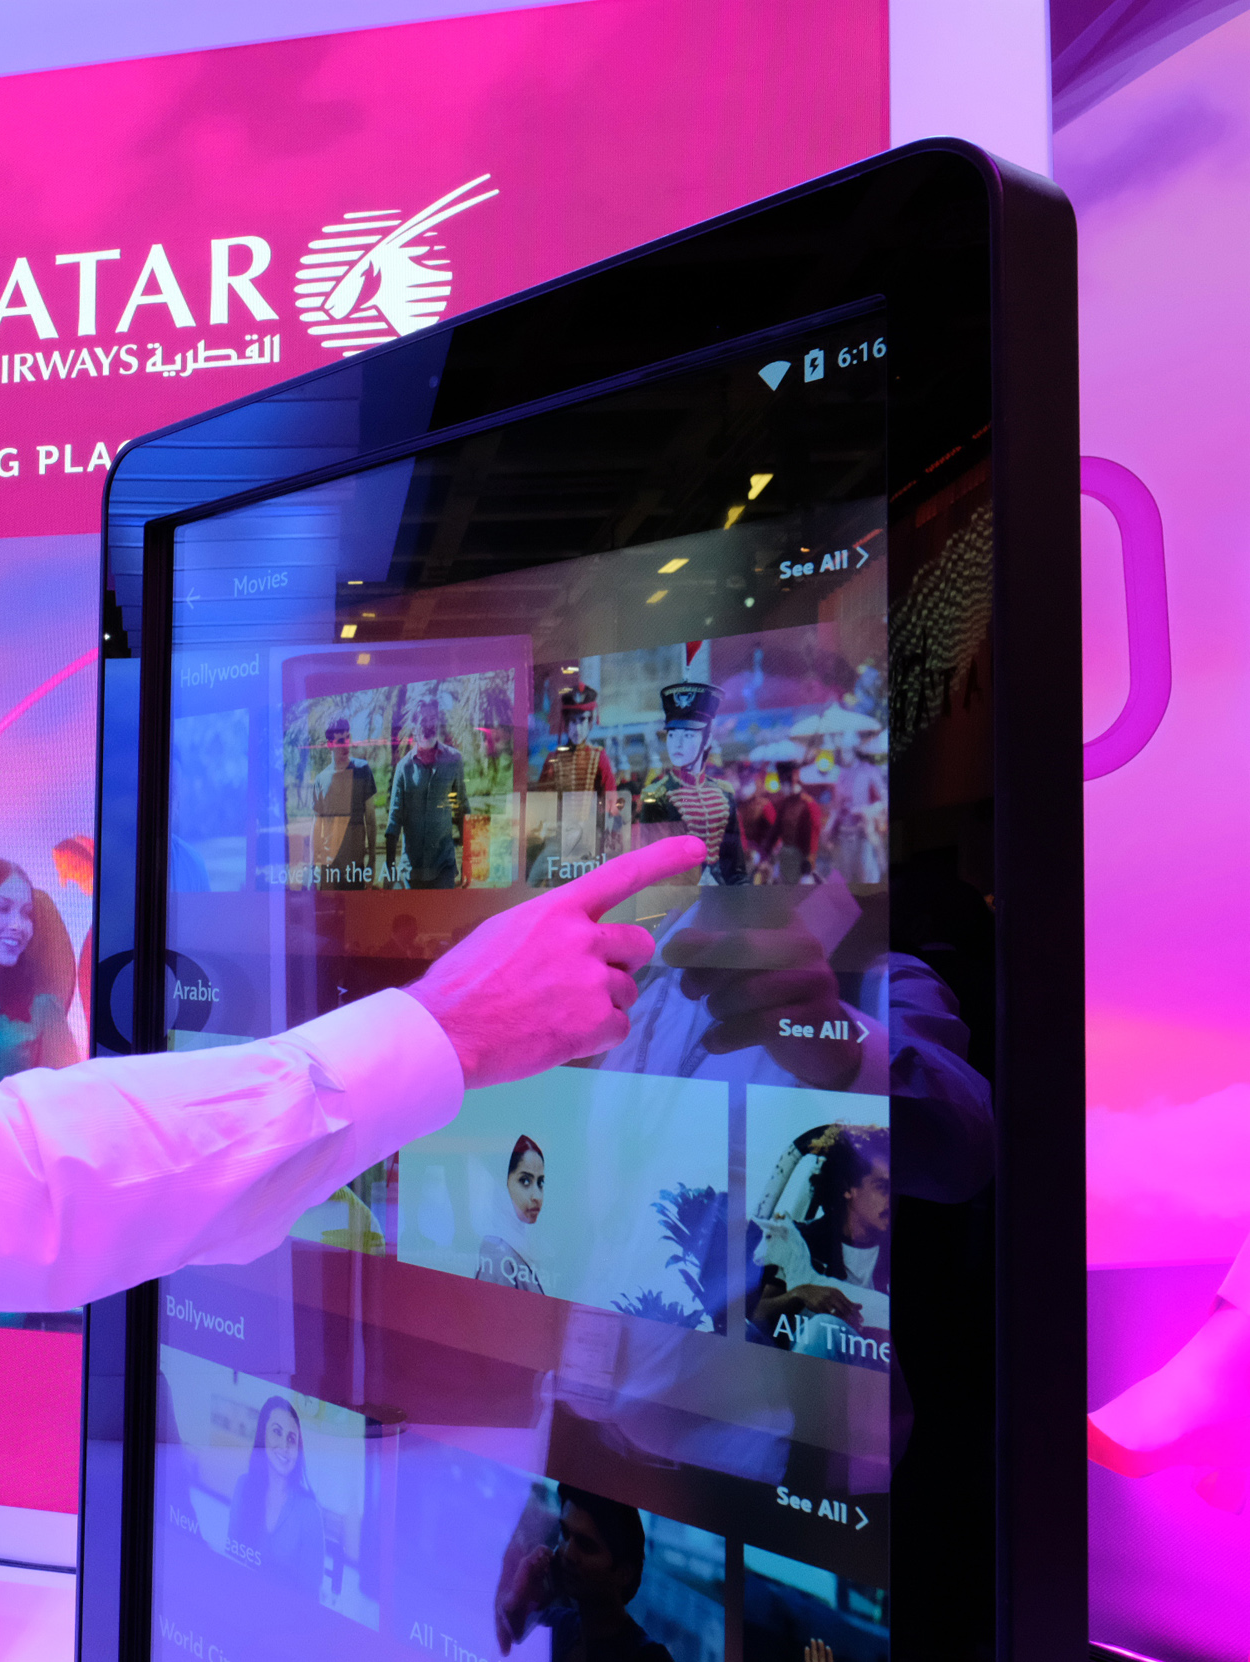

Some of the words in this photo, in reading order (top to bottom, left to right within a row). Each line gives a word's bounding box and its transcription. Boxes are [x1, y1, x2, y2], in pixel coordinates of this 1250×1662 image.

[145, 333, 281, 378] القطرية
[837, 336, 887, 368] 6:16
[35, 439, 132, 476] PLA
[779, 560, 815, 580] See
[819, 549, 849, 574] All
[232, 568, 289, 598] Movies
[179, 652, 260, 690] Hollywood
[269, 864, 305, 885] Love
[325, 863, 341, 884] in
[345, 860, 373, 884] the
[172, 979, 220, 1003] Arabic
[778, 1018, 815, 1038] See
[819, 1020, 849, 1041] All
[166, 1294, 246, 1341] Bollywood
[772, 1313, 810, 1345] All
[169, 1504, 200, 1535] New
[776, 1485, 813, 1513] See
[817, 1498, 848, 1525] All
[158, 1614, 204, 1660] World
[207, 1644, 231, 1662] Ci
[409, 1621, 433, 1650] All
